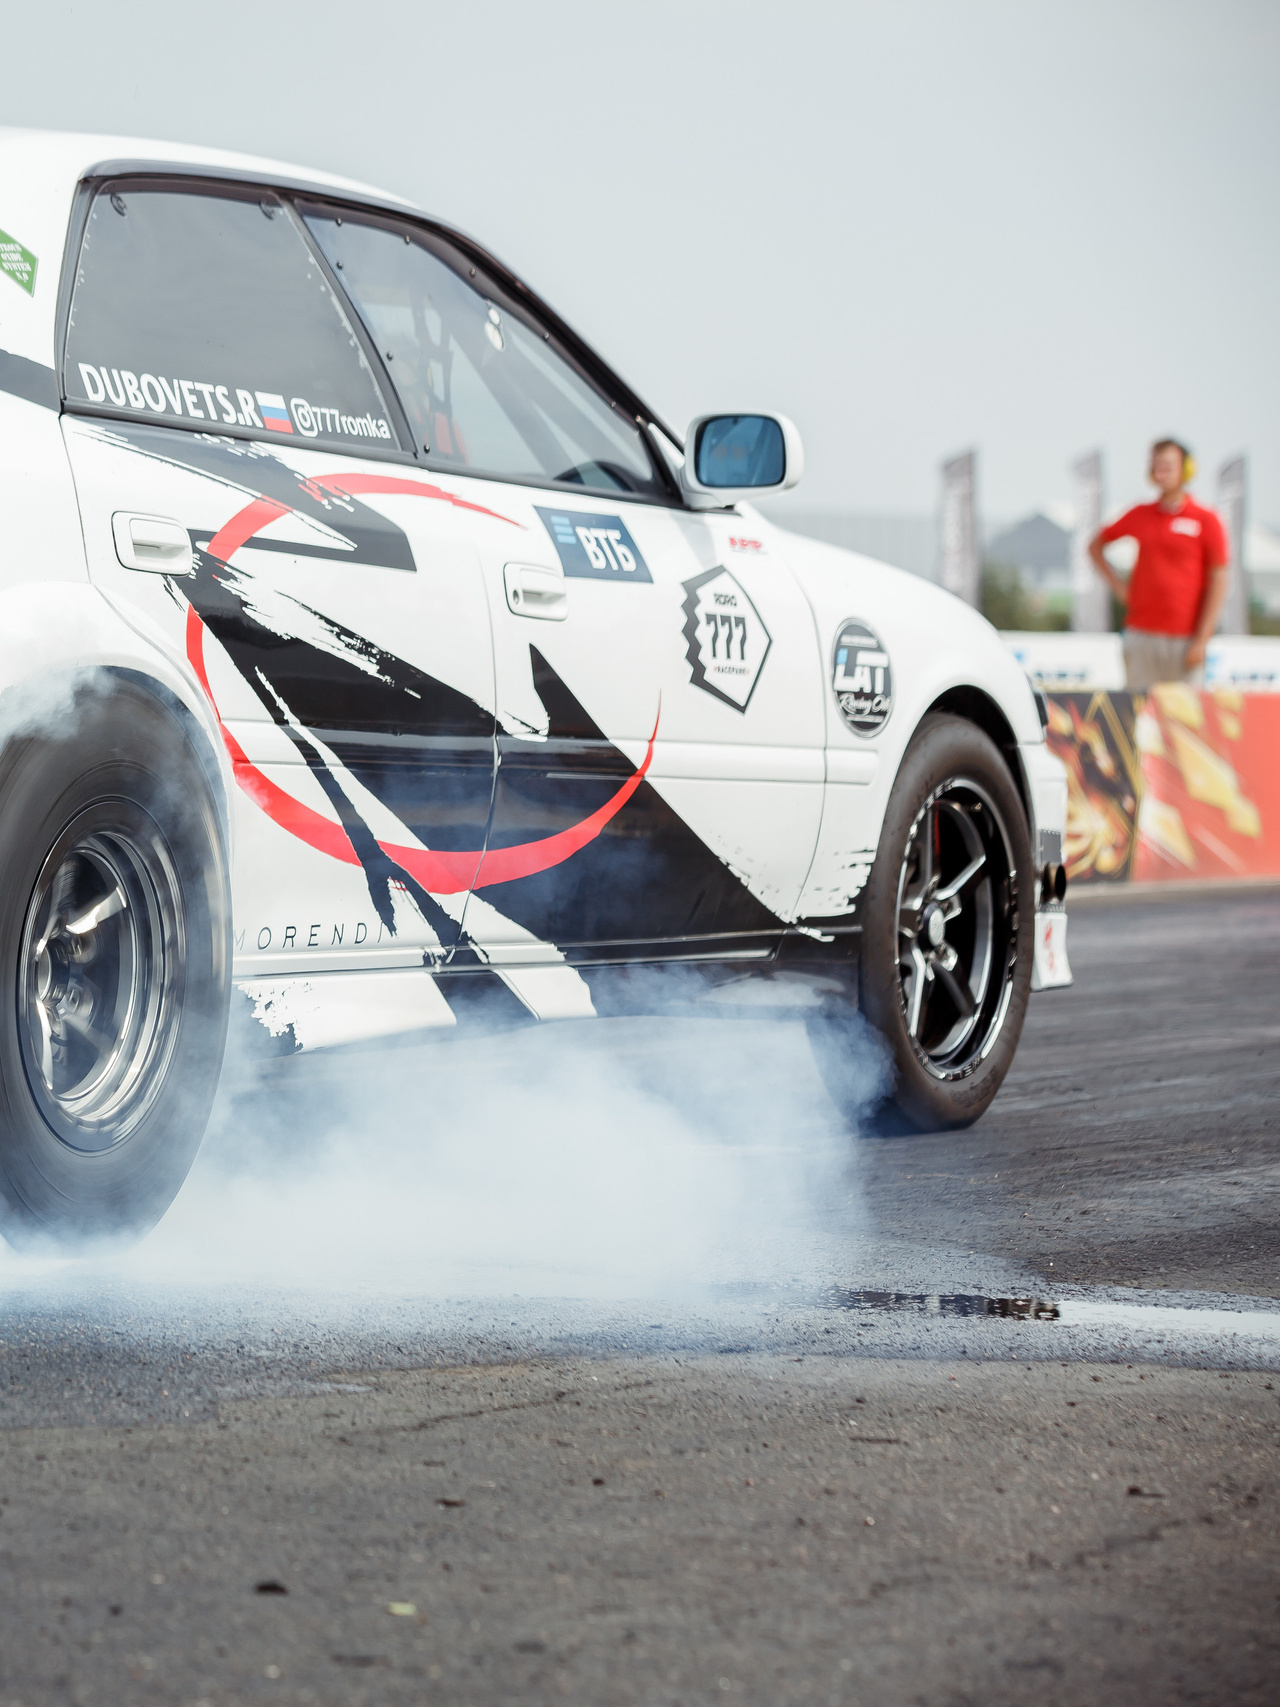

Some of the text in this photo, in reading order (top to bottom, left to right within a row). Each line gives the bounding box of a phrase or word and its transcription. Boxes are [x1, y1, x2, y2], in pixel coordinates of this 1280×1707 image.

[77, 361, 264, 428] DUBOVETS.R
[574, 526, 638, 572] ВТБ
[705, 612, 747, 661] 777
[833, 647, 890, 695] LAT
